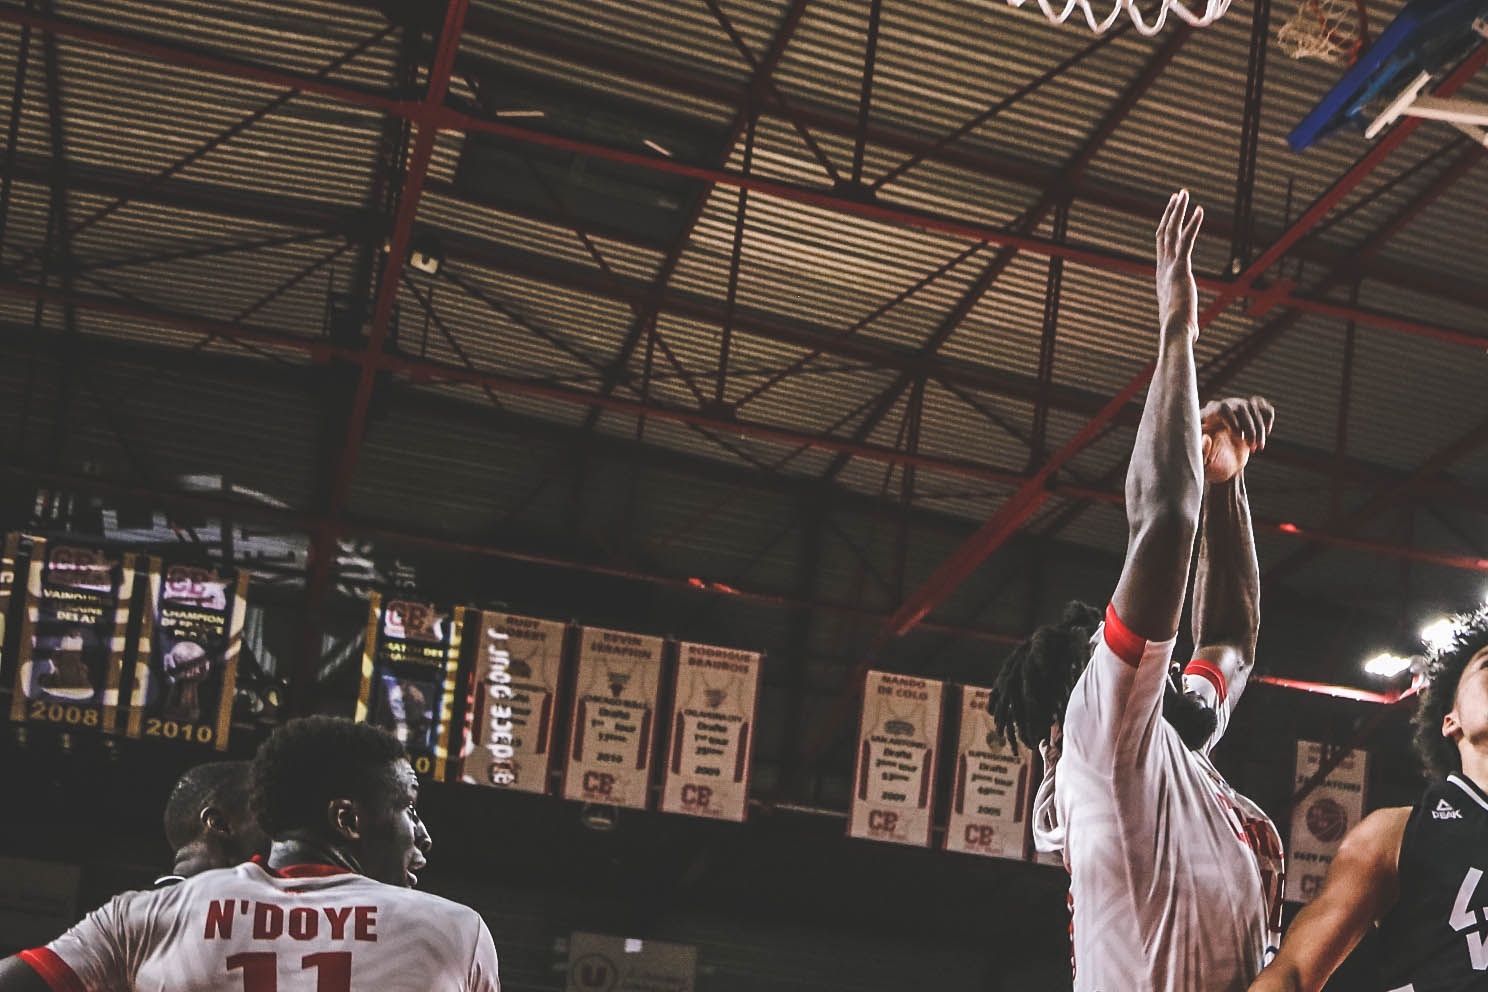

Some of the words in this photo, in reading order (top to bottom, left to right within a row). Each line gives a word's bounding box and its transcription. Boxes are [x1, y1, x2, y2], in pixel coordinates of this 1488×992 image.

[30, 701, 99, 726] 2008
[146, 719, 213, 743] 2010
[583, 770, 615, 794] CB
[681, 783, 713, 807] CB
[868, 810, 898, 832] CB
[964, 823, 994, 846] CB
[204, 899, 378, 942] N'DOYE
